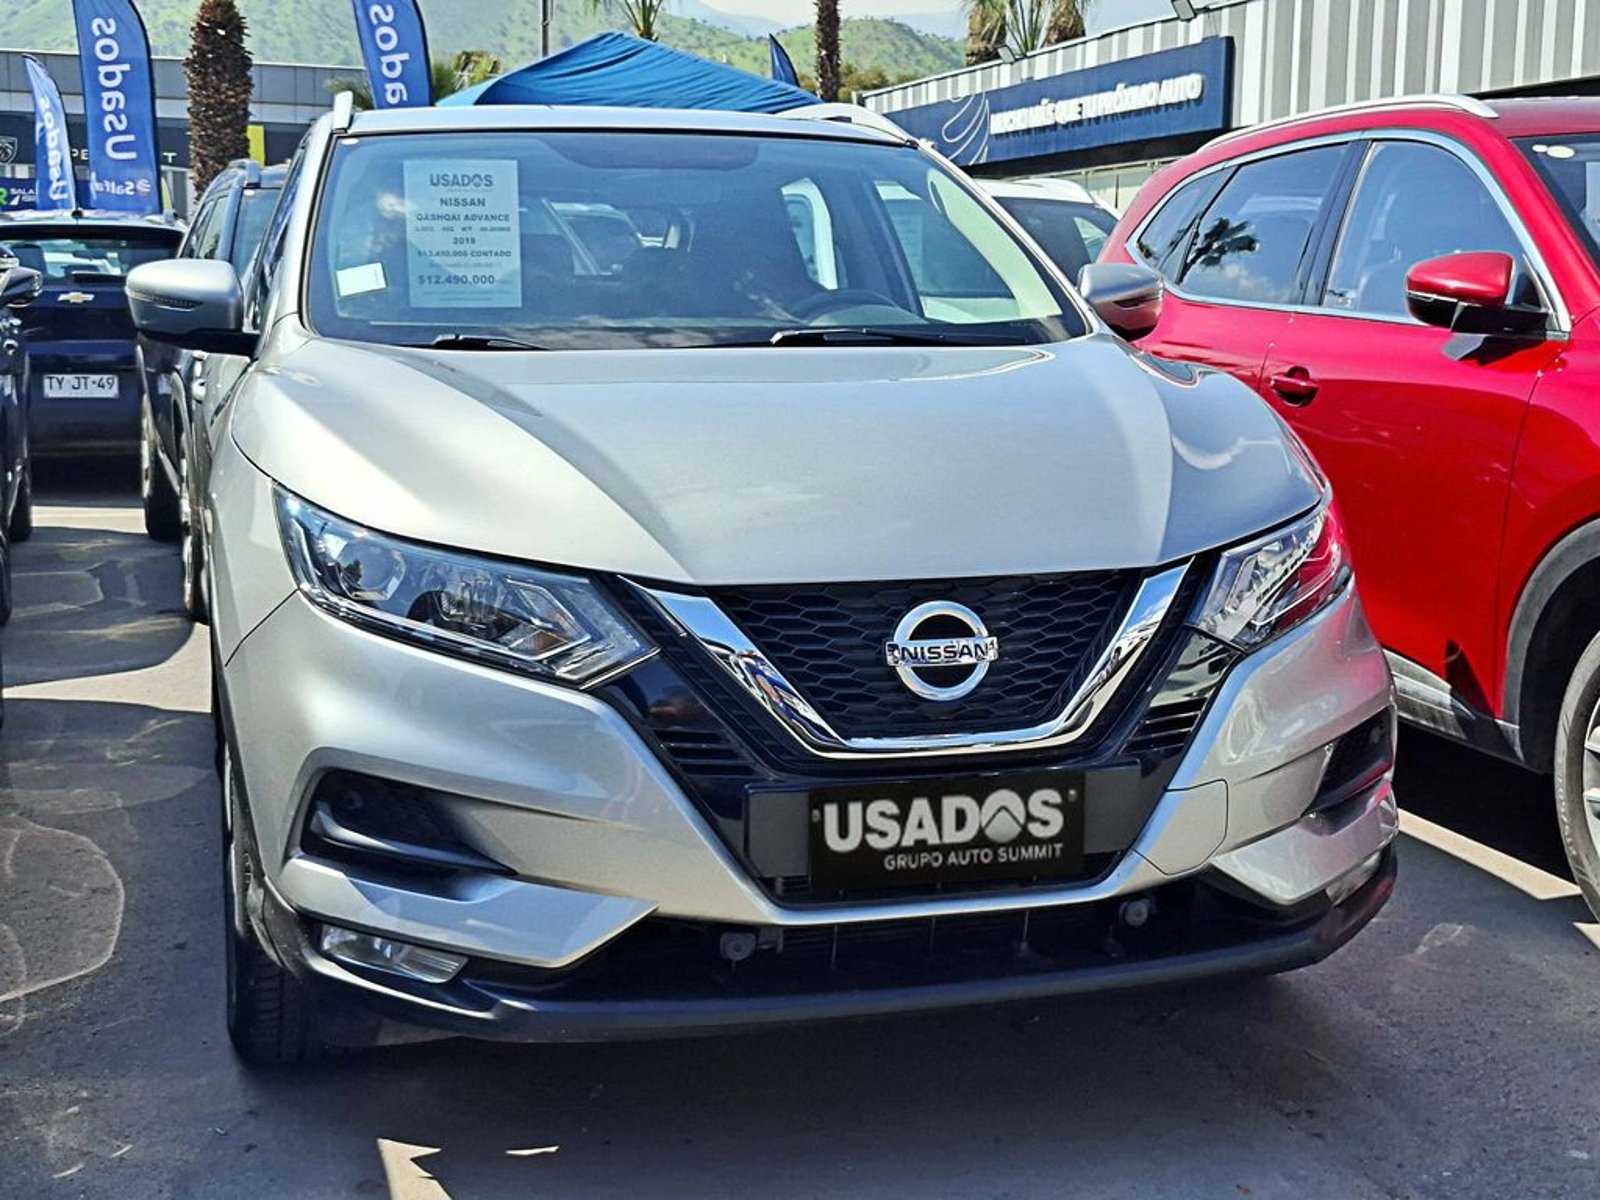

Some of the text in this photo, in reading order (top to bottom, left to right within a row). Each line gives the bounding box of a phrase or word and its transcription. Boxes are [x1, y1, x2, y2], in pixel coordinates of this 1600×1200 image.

[1158, 73, 1202, 104] AUTO
[429, 173, 494, 188] USADOS
[440, 198, 486, 207] NISSAN
[463, 213, 510, 221] ADVANCE
[44, 376, 65, 390] TY
[900, 642, 989, 661] NISSAN
[823, 789, 1064, 852] USADOS
[883, 843, 1063, 870] GRUPO AUTO SUMMIT
